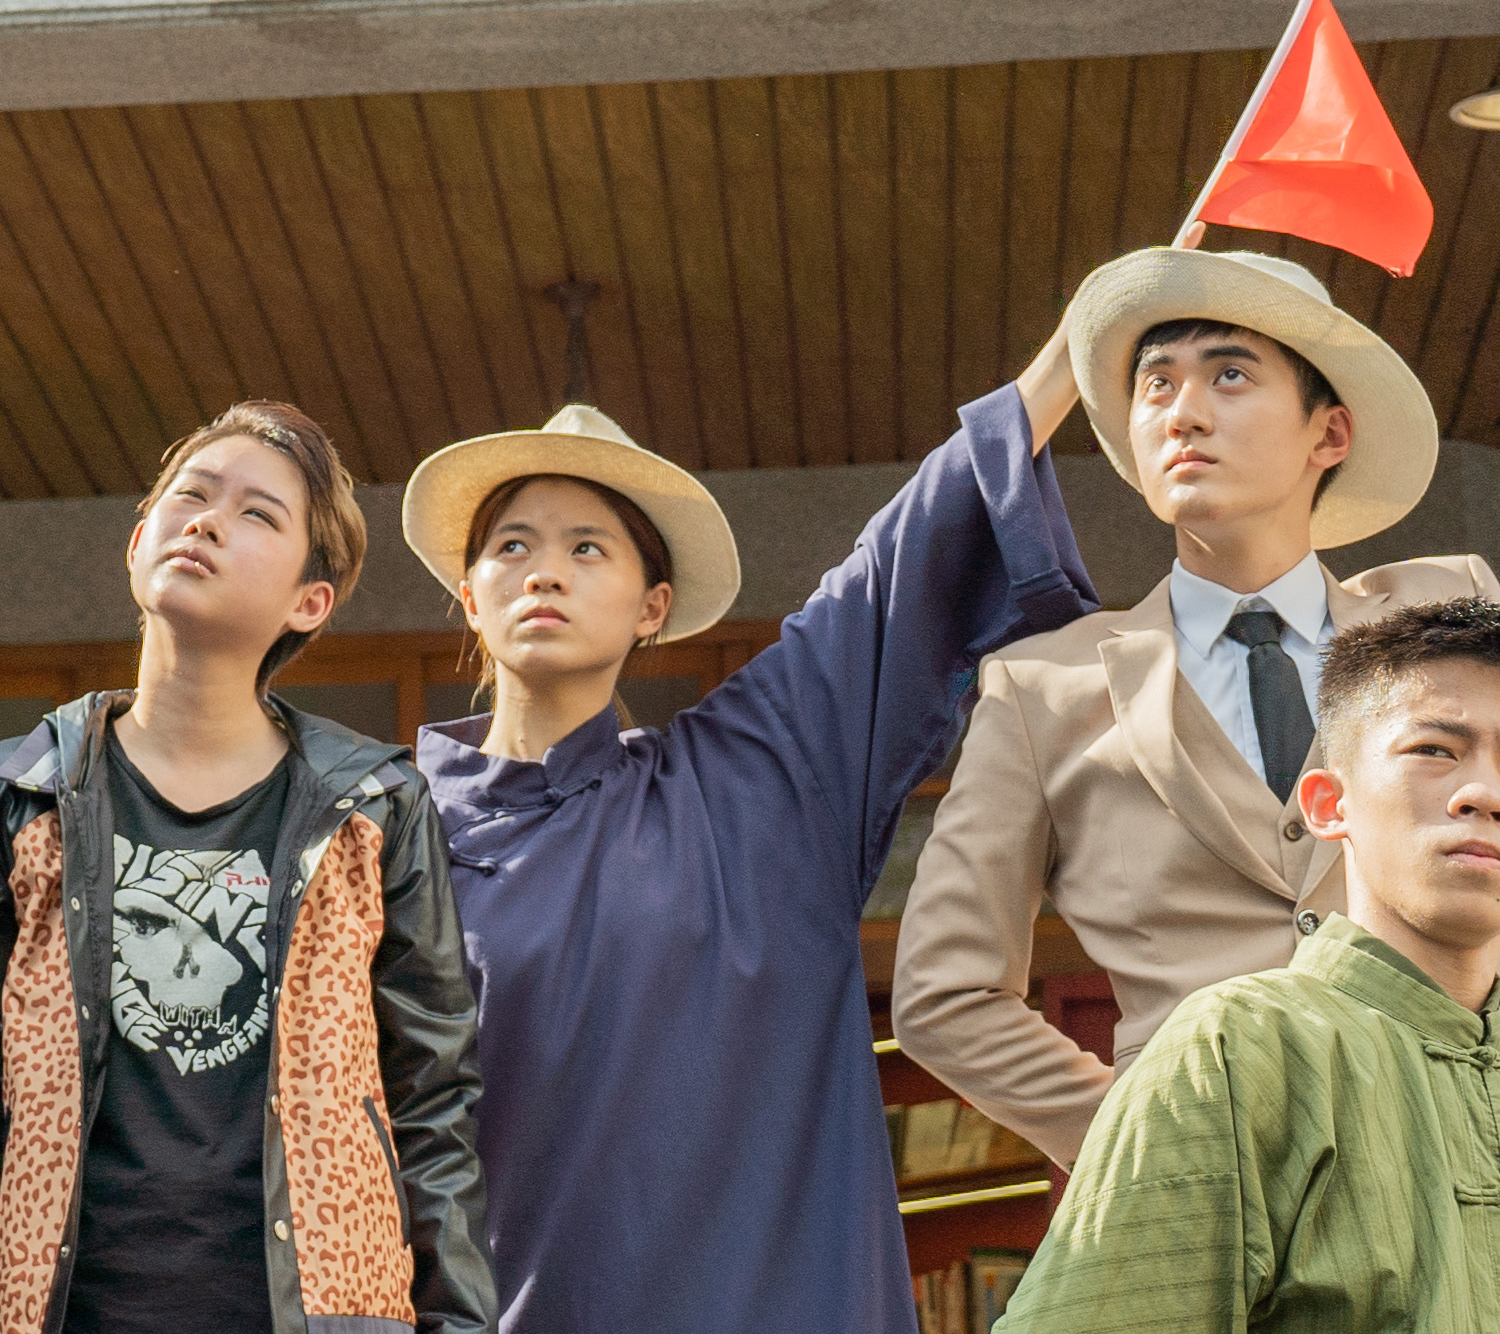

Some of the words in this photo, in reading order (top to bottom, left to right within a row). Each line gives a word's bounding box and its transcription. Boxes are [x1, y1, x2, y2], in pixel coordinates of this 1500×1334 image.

[160, 999, 221, 1029] WITH
[217, 1013, 238, 1035] A
[165, 978, 269, 1077] VENGEAN
